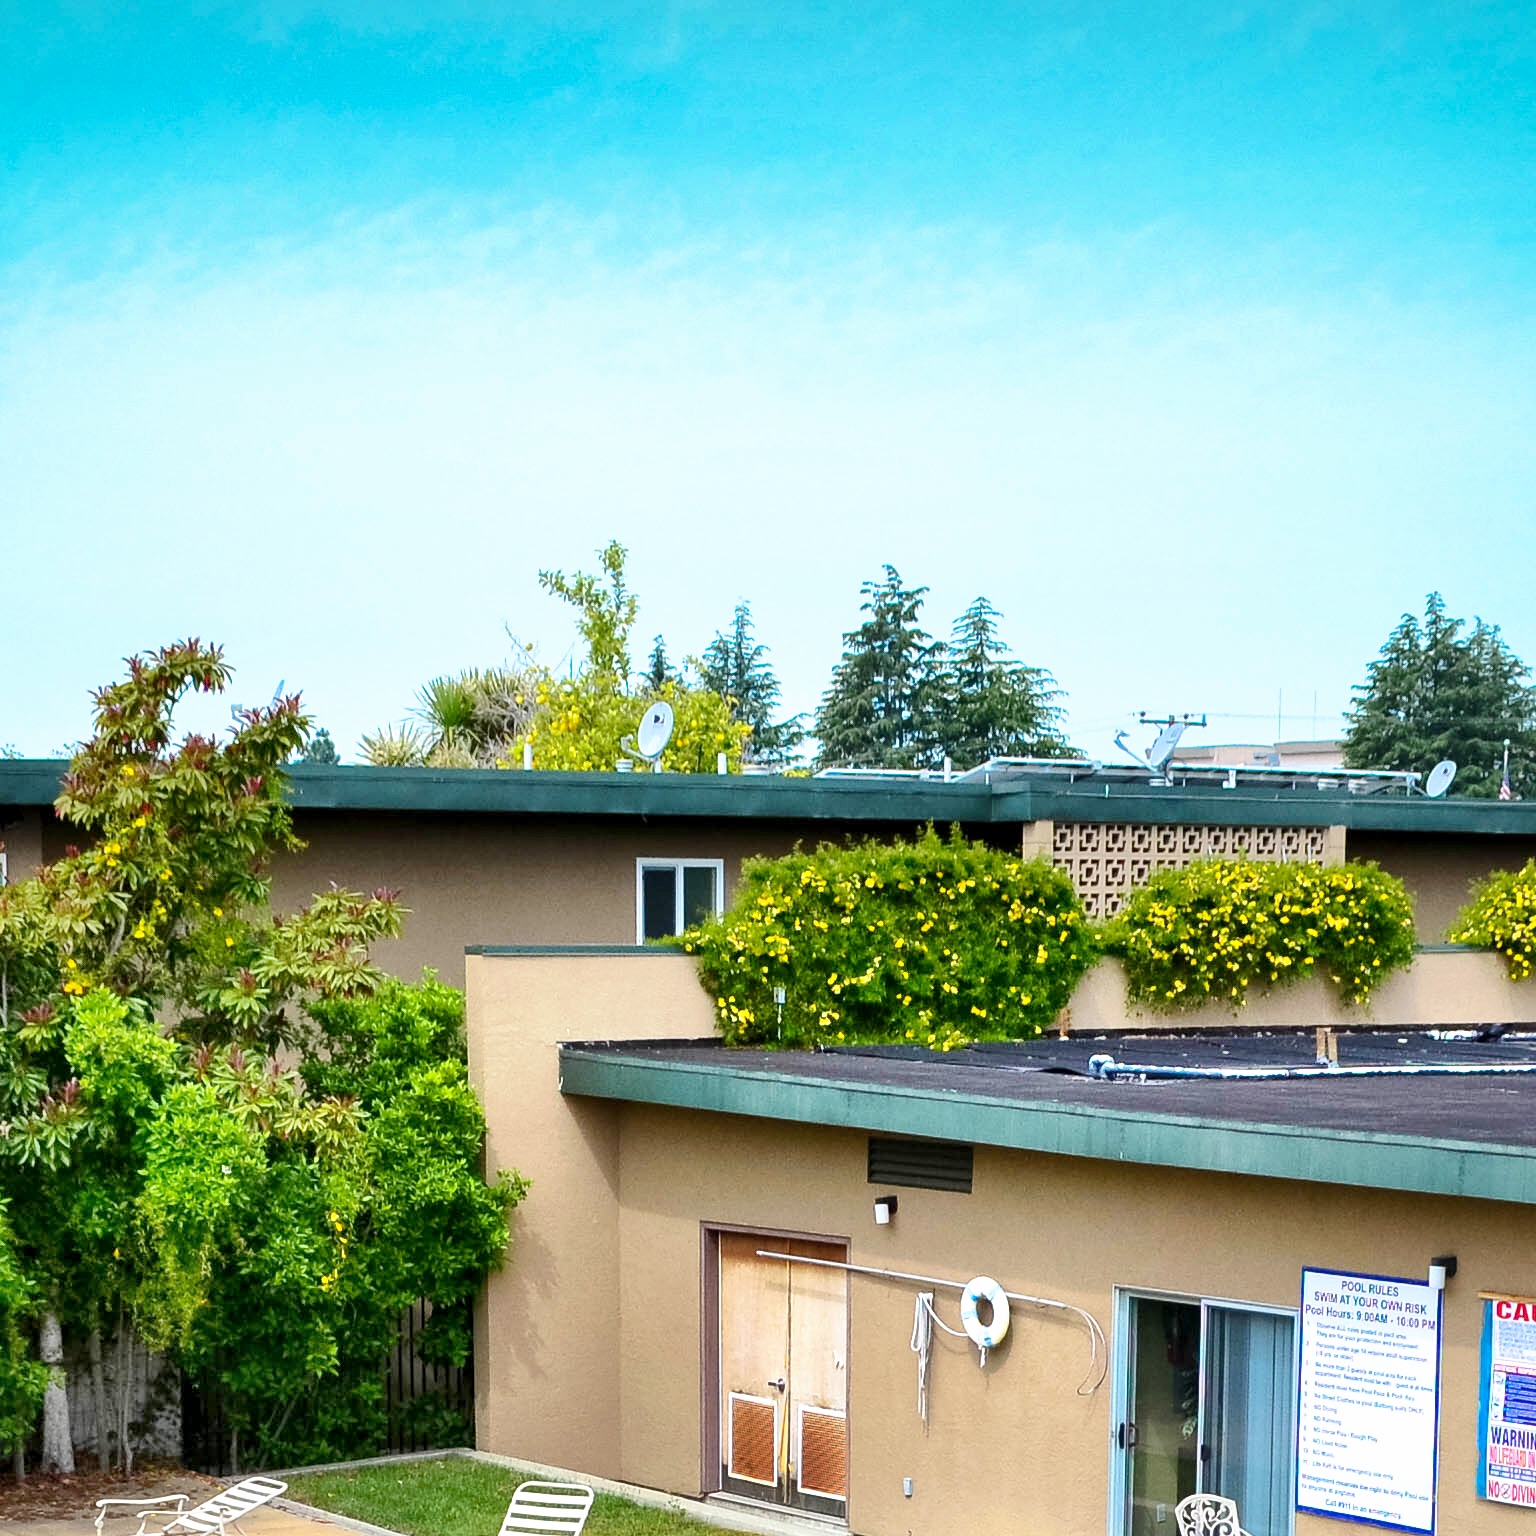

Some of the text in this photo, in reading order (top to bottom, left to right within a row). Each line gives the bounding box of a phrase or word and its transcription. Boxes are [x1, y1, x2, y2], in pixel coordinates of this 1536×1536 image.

[1341, 1280, 1399, 1297] POOL RULES
[1314, 1291, 1427, 1315] SWIM AT YOUR OWN RISK
[1305, 1304, 1324, 1316] Pool
[1396, 1316, 1419, 1328] 10:00
[1421, 1319, 1436, 1330] PM
[1489, 1480, 1500, 1498] NO
